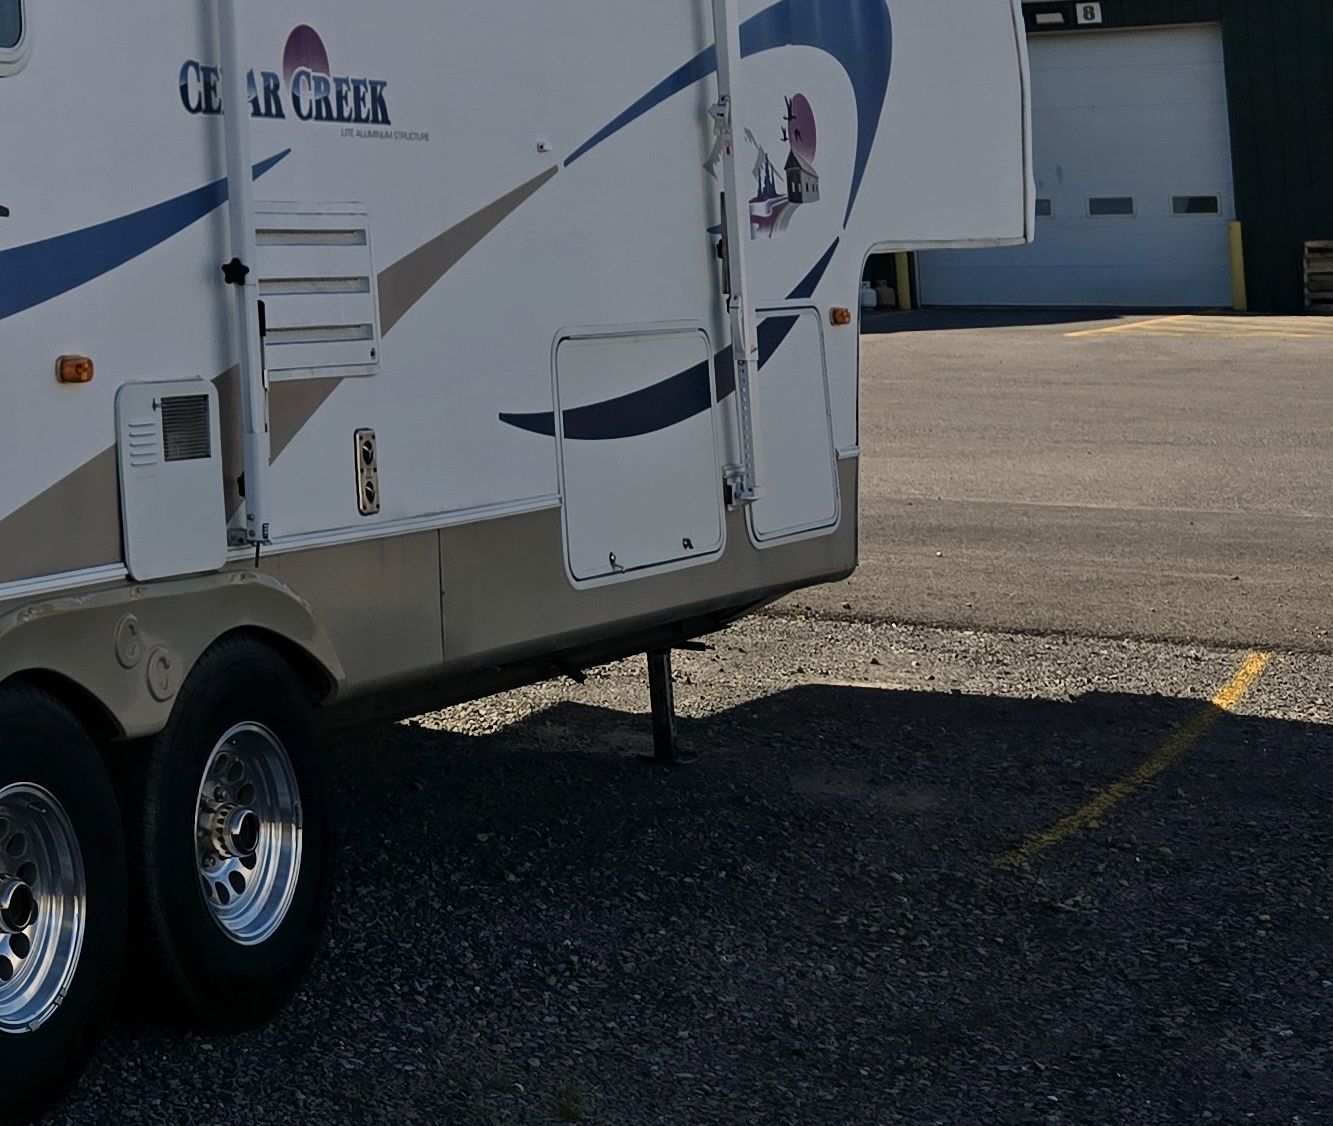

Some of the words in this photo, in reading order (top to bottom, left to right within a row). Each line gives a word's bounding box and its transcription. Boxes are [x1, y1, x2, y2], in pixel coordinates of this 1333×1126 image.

[1083, 6, 1095, 20] 8
[179, 60, 286, 119] CEAR
[291, 68, 392, 125] CREEK
